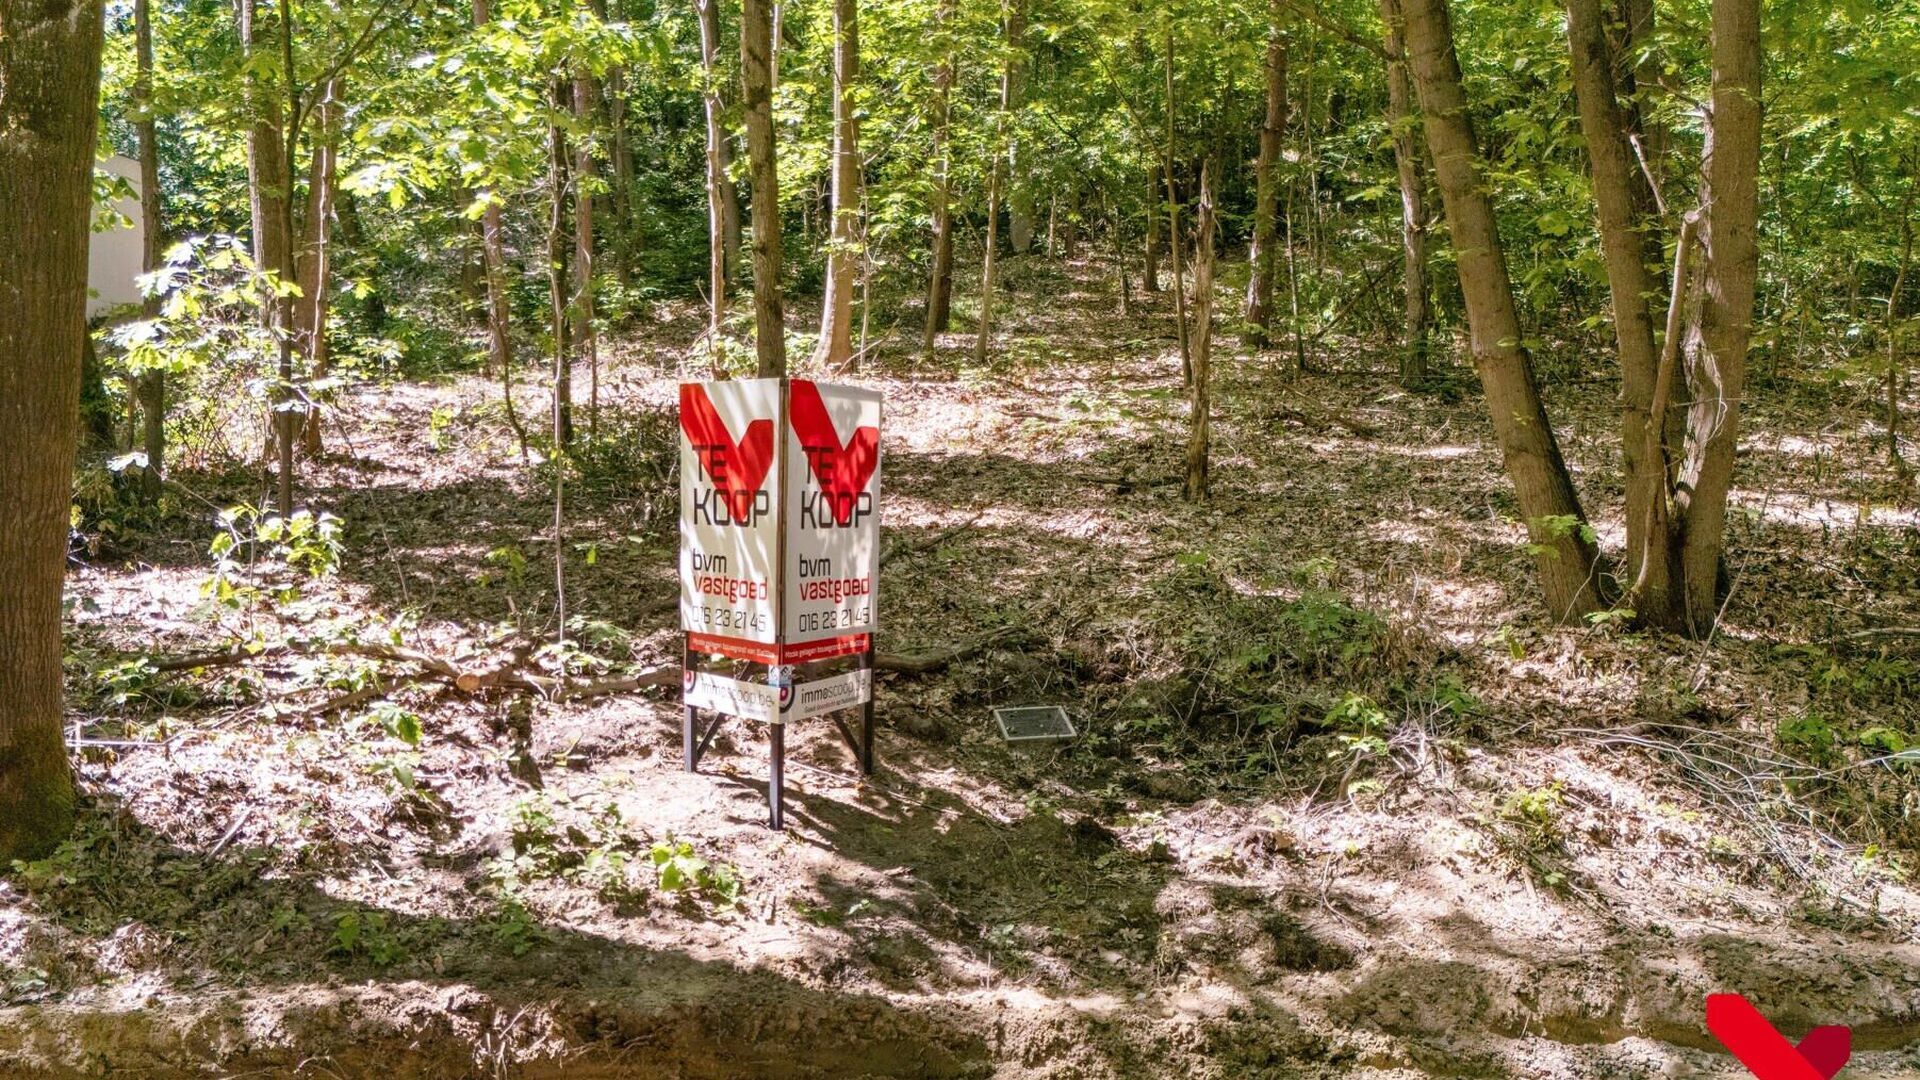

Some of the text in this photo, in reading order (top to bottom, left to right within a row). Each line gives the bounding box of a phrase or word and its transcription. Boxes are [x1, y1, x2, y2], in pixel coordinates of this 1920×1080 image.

[692, 444, 727, 482] TE
[801, 445, 834, 485] TE
[693, 488, 769, 528] KOOP
[801, 490, 872, 529] KOOP
[693, 548, 727, 573] bvm
[800, 553, 831, 578] bvm
[693, 574, 768, 604] vastgoed
[800, 572, 870, 604] vastgoed
[692, 605, 766, 633] 016 23 21 45
[799, 607, 870, 632] 016 23 21 45
